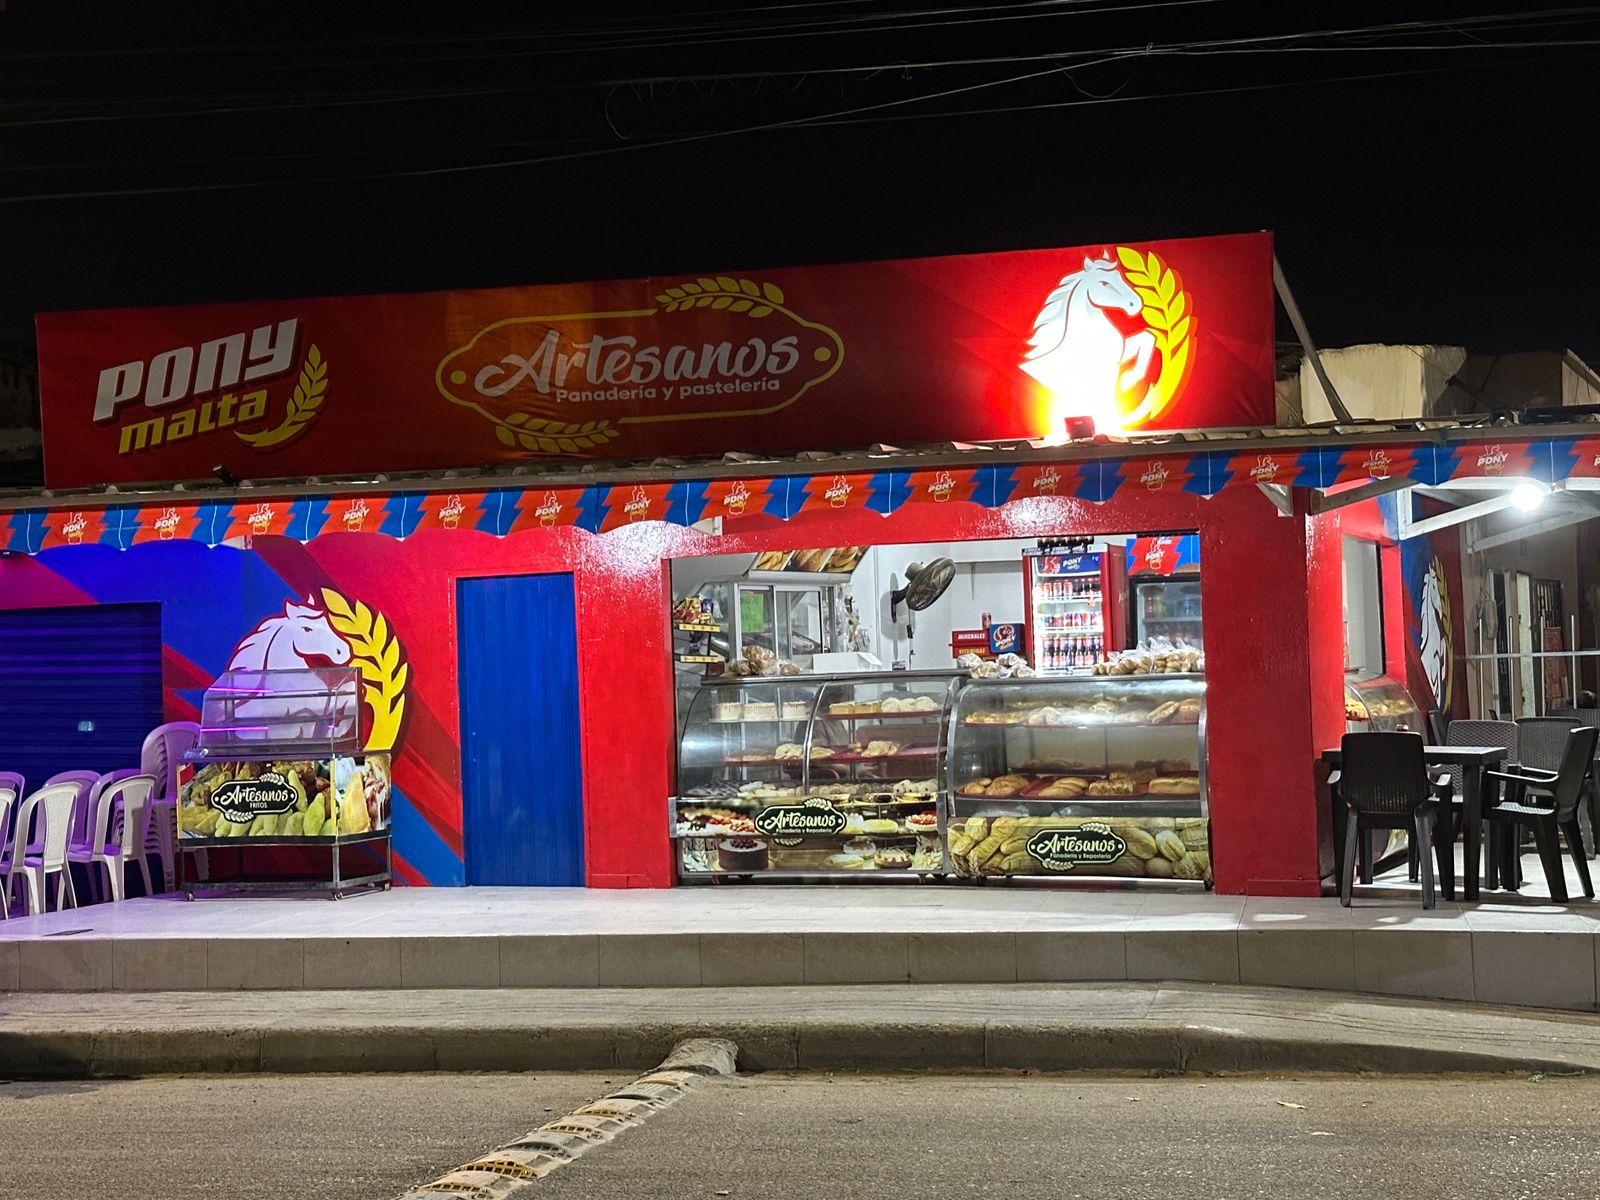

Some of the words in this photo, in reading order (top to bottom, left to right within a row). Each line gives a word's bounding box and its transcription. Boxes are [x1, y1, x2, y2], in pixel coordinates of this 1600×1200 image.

[474, 329, 800, 397] Artesanos
[556, 384, 656, 402] Panadería
[662, 387, 674, 400] y
[680, 377, 781, 398] pastelería
[119, 389, 267, 454] malta
[1477, 453, 1508, 466] PONY
[1140, 470, 1170, 483] PONY
[1250, 464, 1279, 477] PONY
[927, 480, 956, 493] PONY
[1033, 475, 1061, 488] PONY
[723, 491, 751, 505] PONY
[824, 484, 854, 499] PONY
[438, 505, 464, 519] PONY
[535, 504, 562, 517] PONY
[624, 499, 651, 512] PONY
[247, 511, 275, 525] PONY
[343, 508, 370, 522] PONY
[62, 520, 87, 535] PONY
[154, 516, 181, 530] PONY
[1063, 556, 1082, 568] PONY
[220, 785, 288, 805] Artesanos
[764, 810, 836, 829] Artesanos
[1037, 834, 1115, 853] Artesanos
